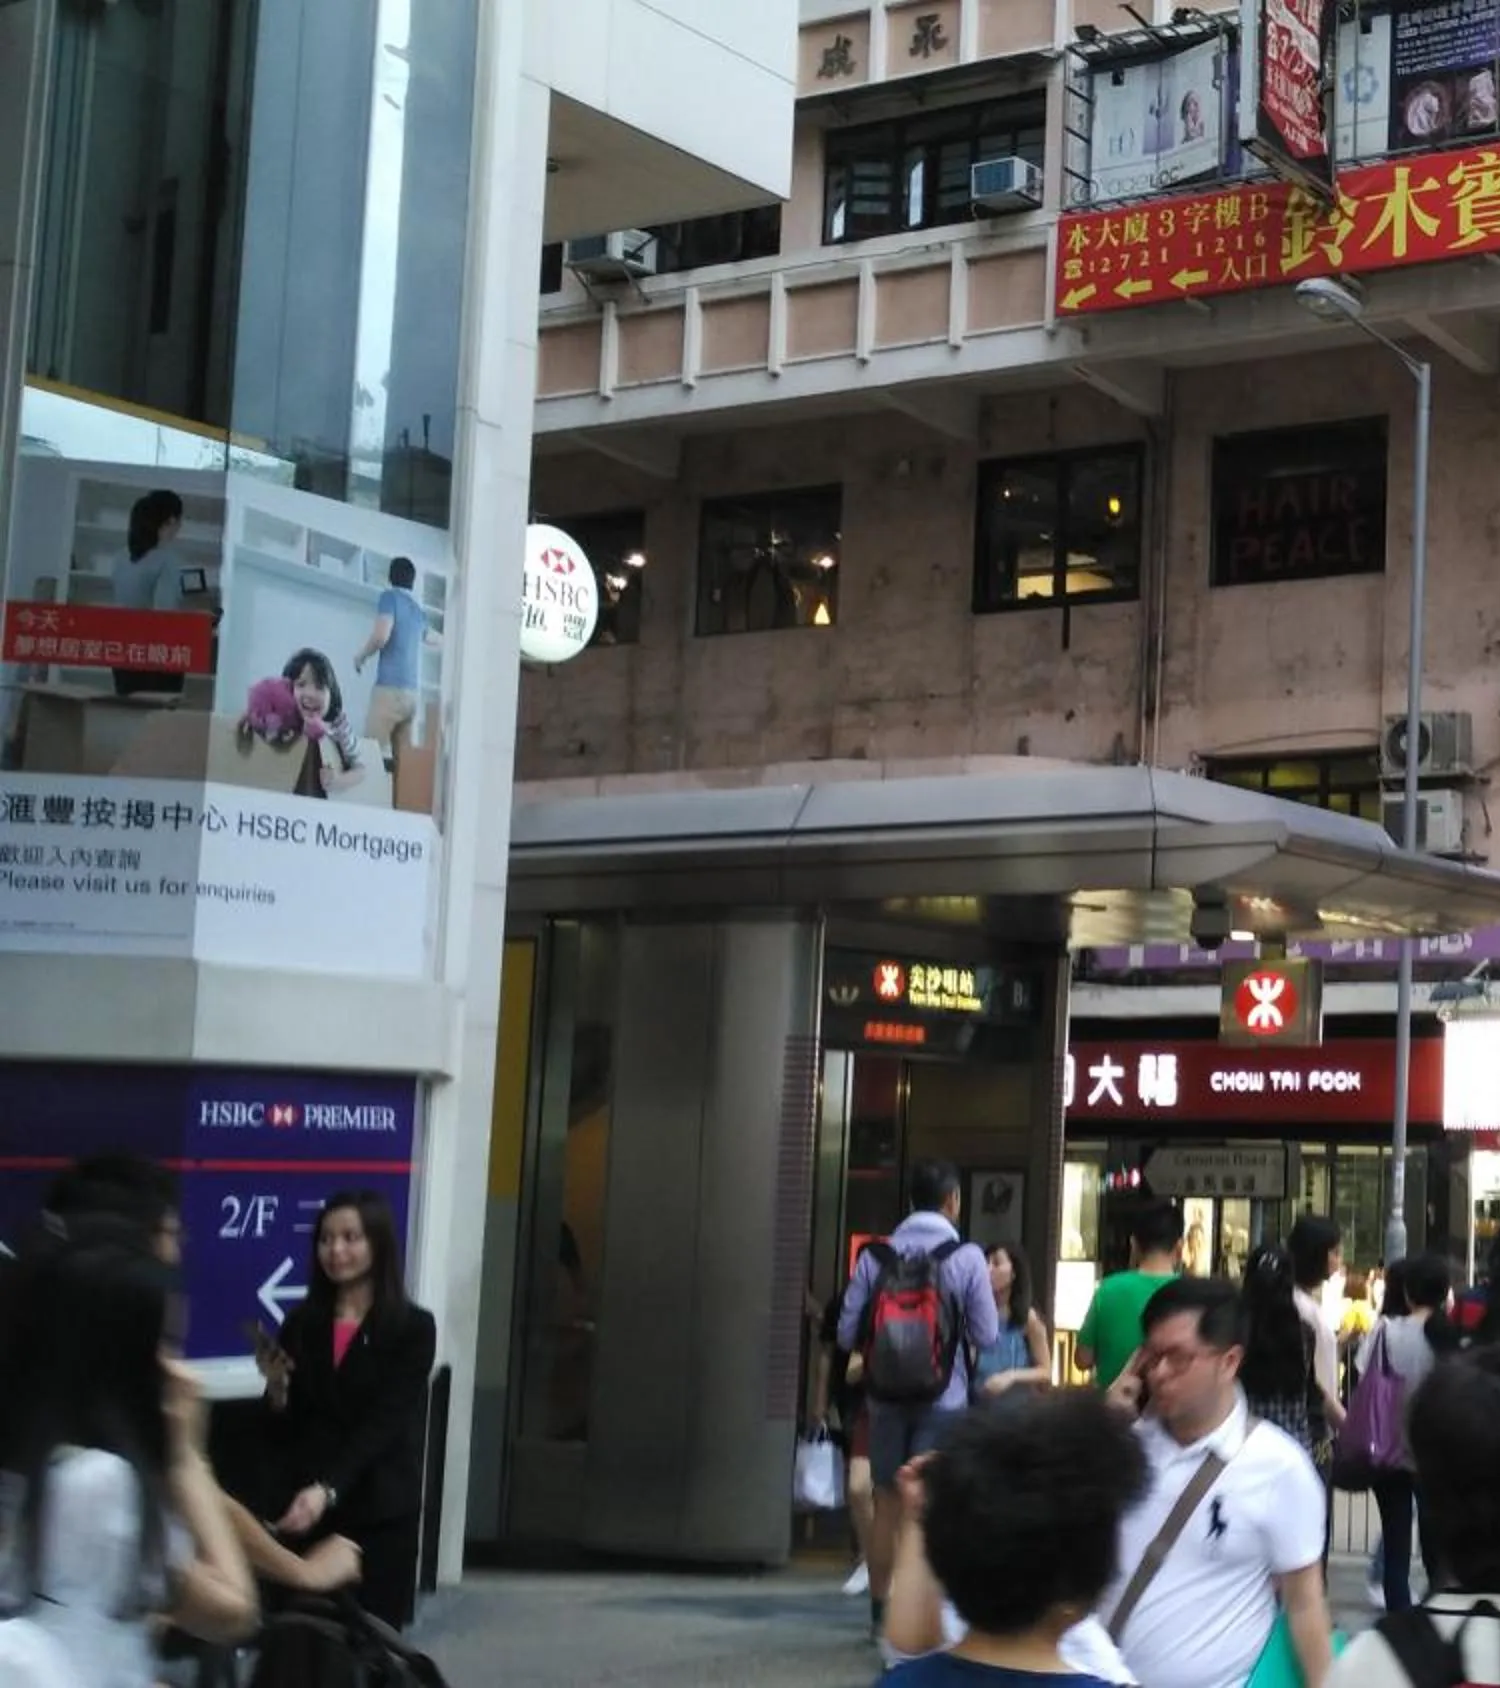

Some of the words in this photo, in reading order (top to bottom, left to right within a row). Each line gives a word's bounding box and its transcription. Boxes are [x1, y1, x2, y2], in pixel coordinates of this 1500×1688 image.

[1221, 253, 1268, 284] 入口
[523, 572, 589, 613] HSBC
[238, 811, 307, 844] HSBC
[315, 821, 423, 862] Mortgage
[0, 869, 65, 890] Please
[73, 873, 117, 893] visit
[125, 879, 152, 894] us
[160, 876, 189, 895] for
[195, 881, 276, 905] enquiries
[1064, 1053, 1178, 1107] 大福
[1210, 1070, 1264, 1093] CHOW
[1269, 1070, 1301, 1092] TAI
[1308, 1070, 1362, 1092] FOOK
[200, 1101, 265, 1128] HSBC
[303, 1104, 397, 1132] PREMIER
[219, 1195, 279, 1238] 2/F
